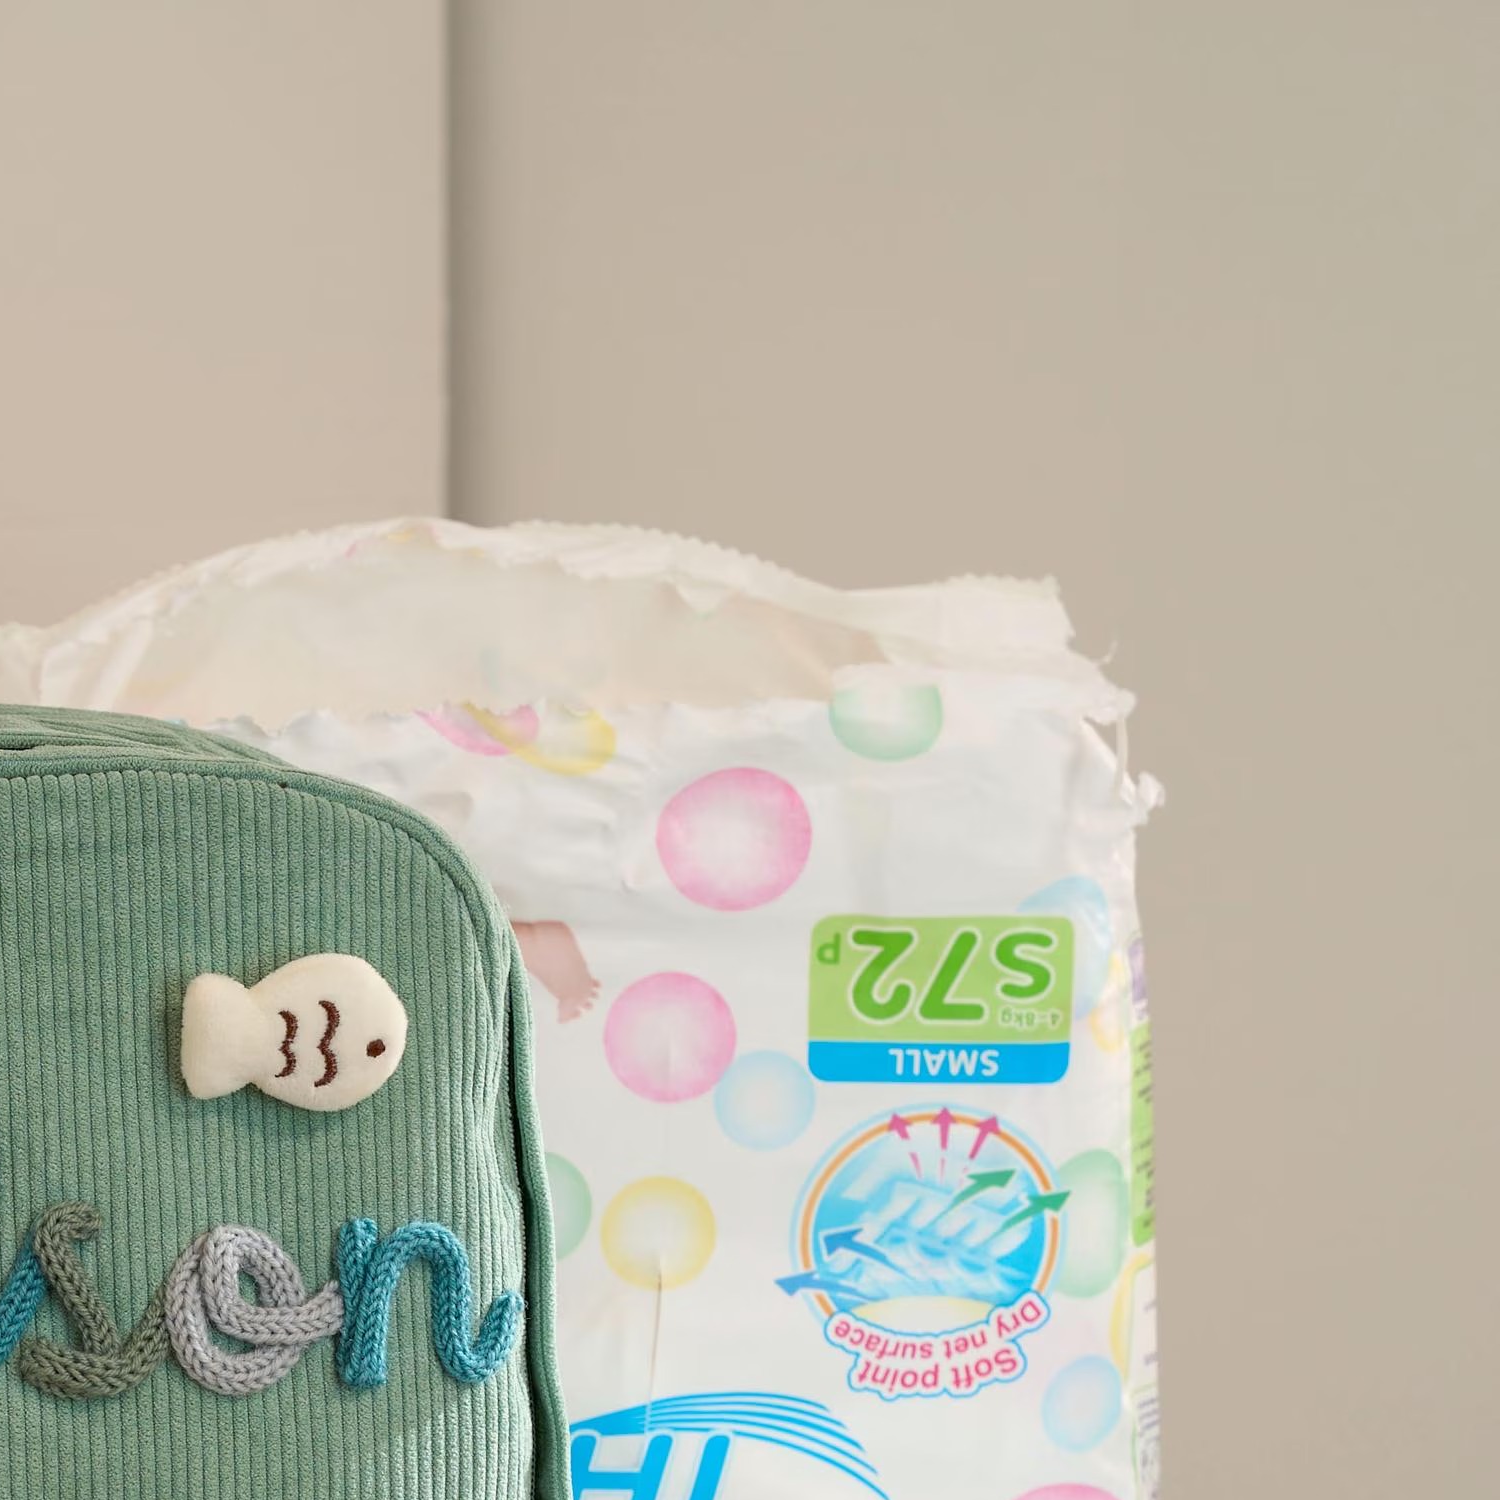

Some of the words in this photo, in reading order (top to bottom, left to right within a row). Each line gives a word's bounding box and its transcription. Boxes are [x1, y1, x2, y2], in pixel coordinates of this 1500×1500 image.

[888, 1047, 1000, 1076] SMALL
[997, 1300, 1042, 1338] Dry
[834, 1319, 934, 1359] surface
[944, 1331, 988, 1360] net
[858, 1361, 940, 1392] point
[951, 1349, 1018, 1388] Soft
